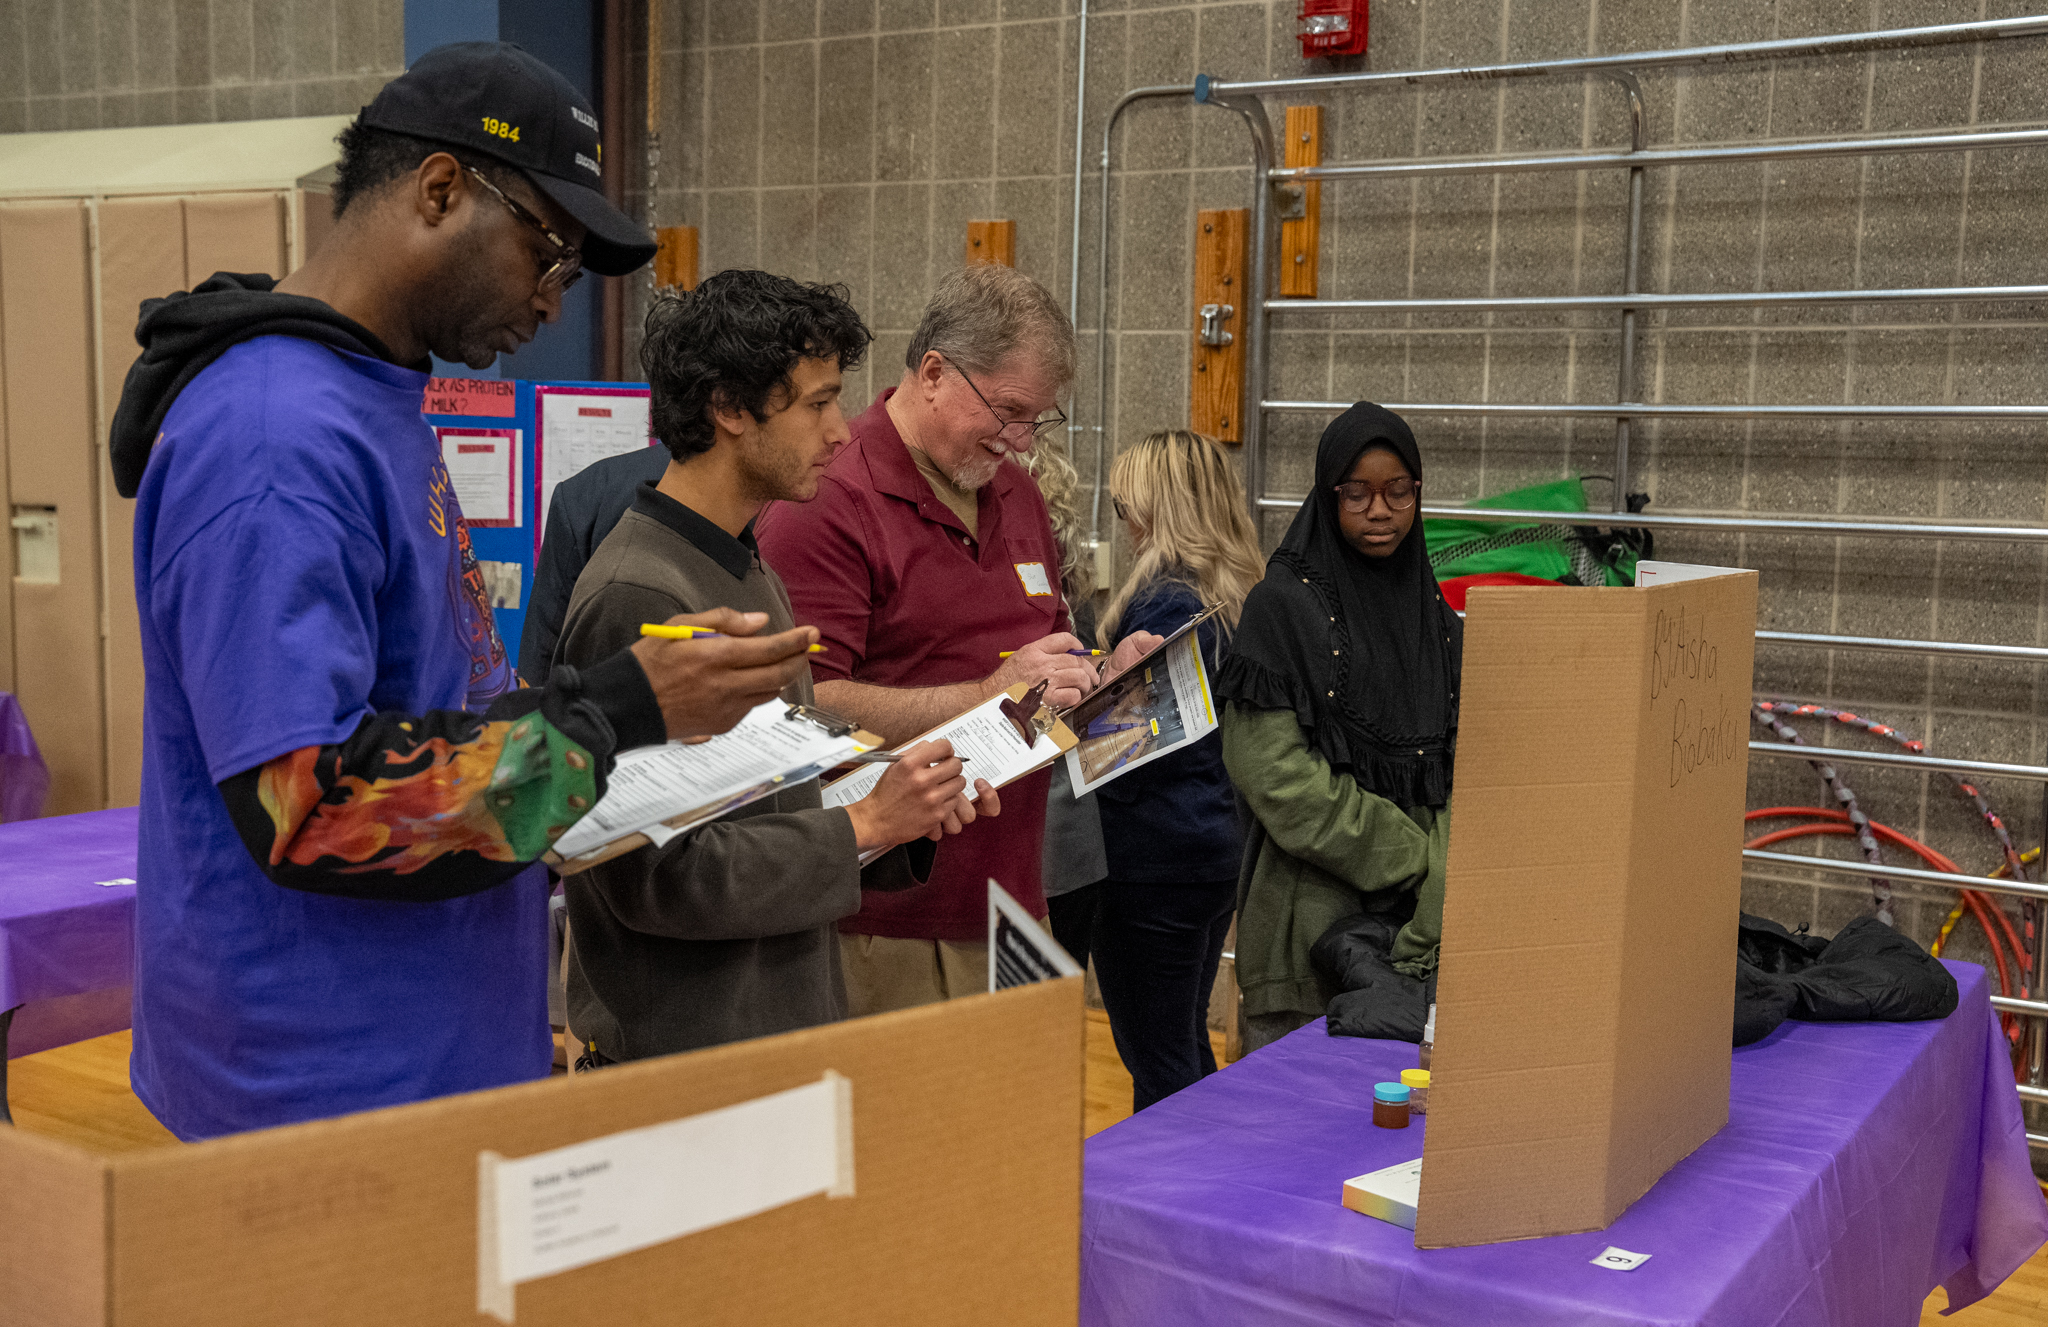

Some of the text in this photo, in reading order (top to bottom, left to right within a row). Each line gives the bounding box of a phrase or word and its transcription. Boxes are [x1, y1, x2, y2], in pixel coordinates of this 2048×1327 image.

[482, 117, 520, 142] 1984
[428, 378, 514, 396] ILK AS PROTEIN
